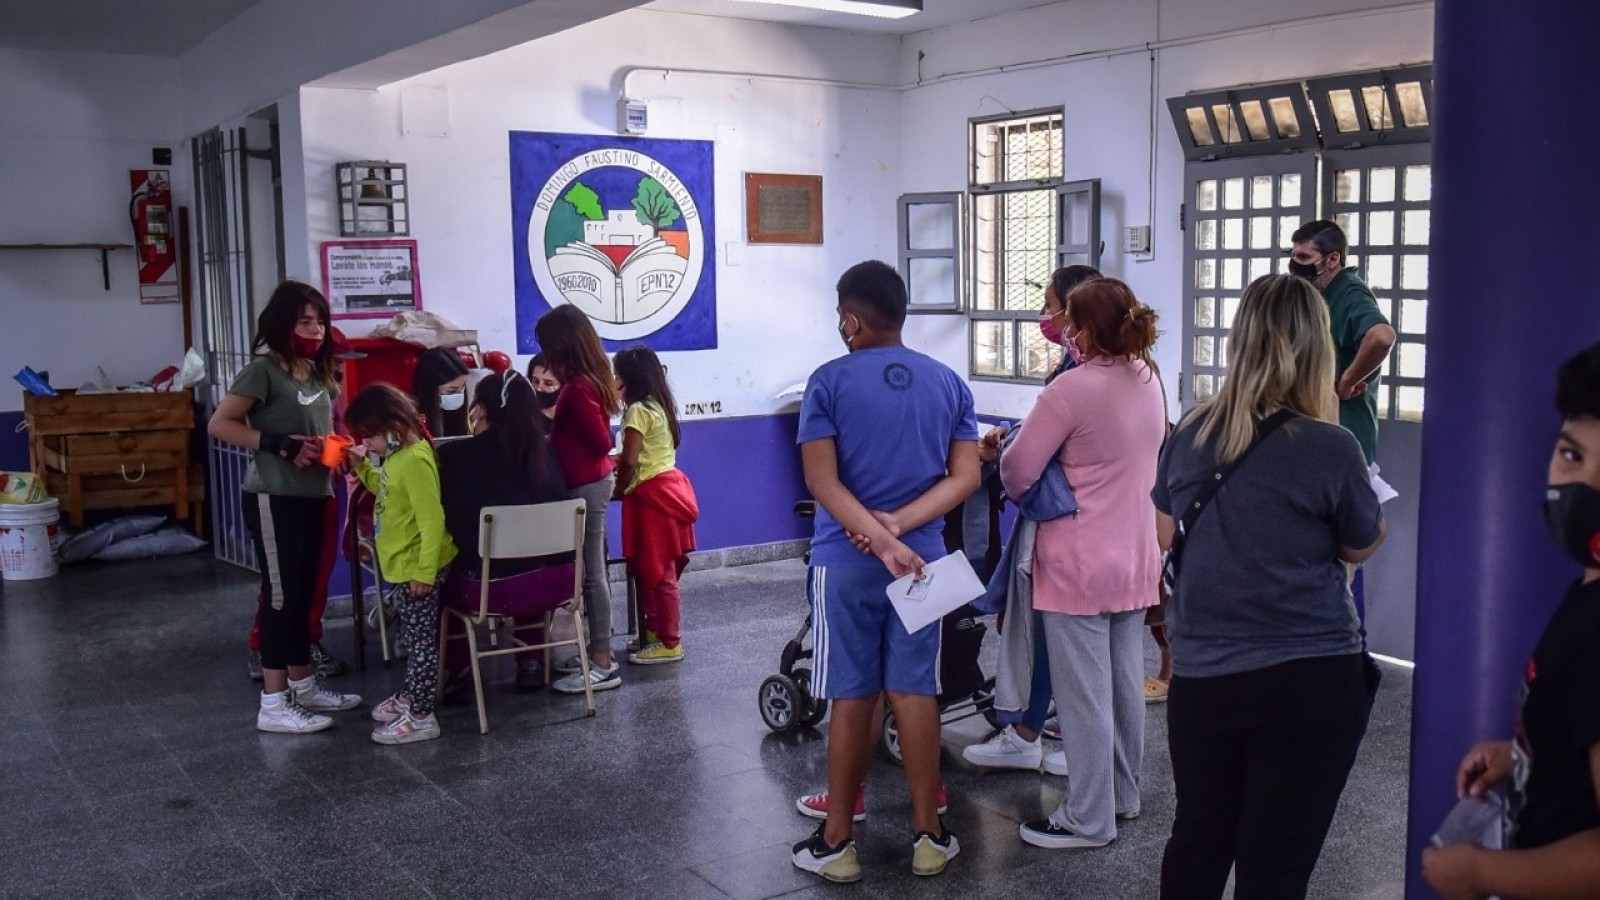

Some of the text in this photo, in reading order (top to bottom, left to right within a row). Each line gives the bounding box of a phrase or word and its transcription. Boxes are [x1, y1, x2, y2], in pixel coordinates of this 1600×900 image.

[536, 161, 580, 212] DOMINGO
[584, 150, 640, 168] FAUSTINO
[647, 161, 697, 221] SARMIENTO
[710, 400, 722, 413] 12
